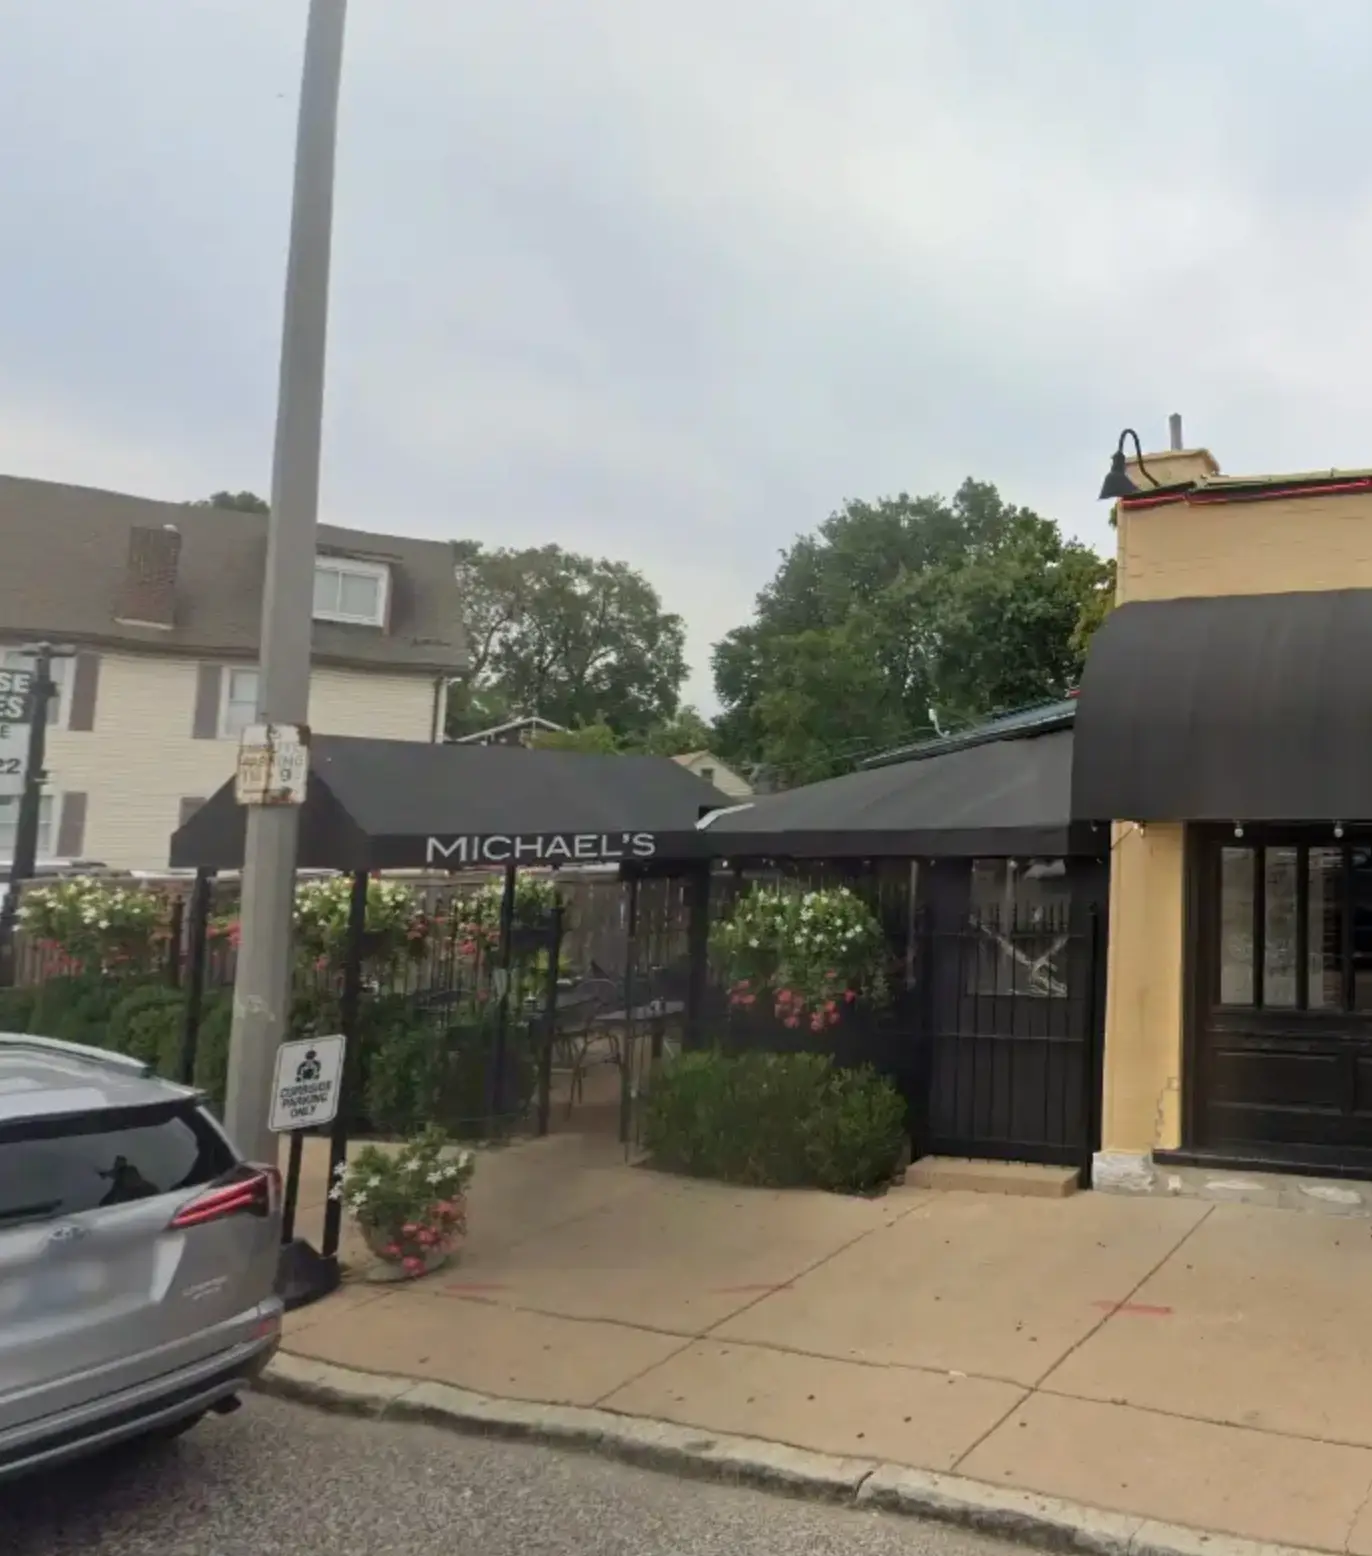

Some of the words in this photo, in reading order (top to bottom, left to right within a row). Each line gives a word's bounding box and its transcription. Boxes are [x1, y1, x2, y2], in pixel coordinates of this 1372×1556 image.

[426, 833, 656, 863] MICHAEL'S
[282, 1092, 328, 1110] PARKING
[290, 1104, 317, 1118] ONLY
